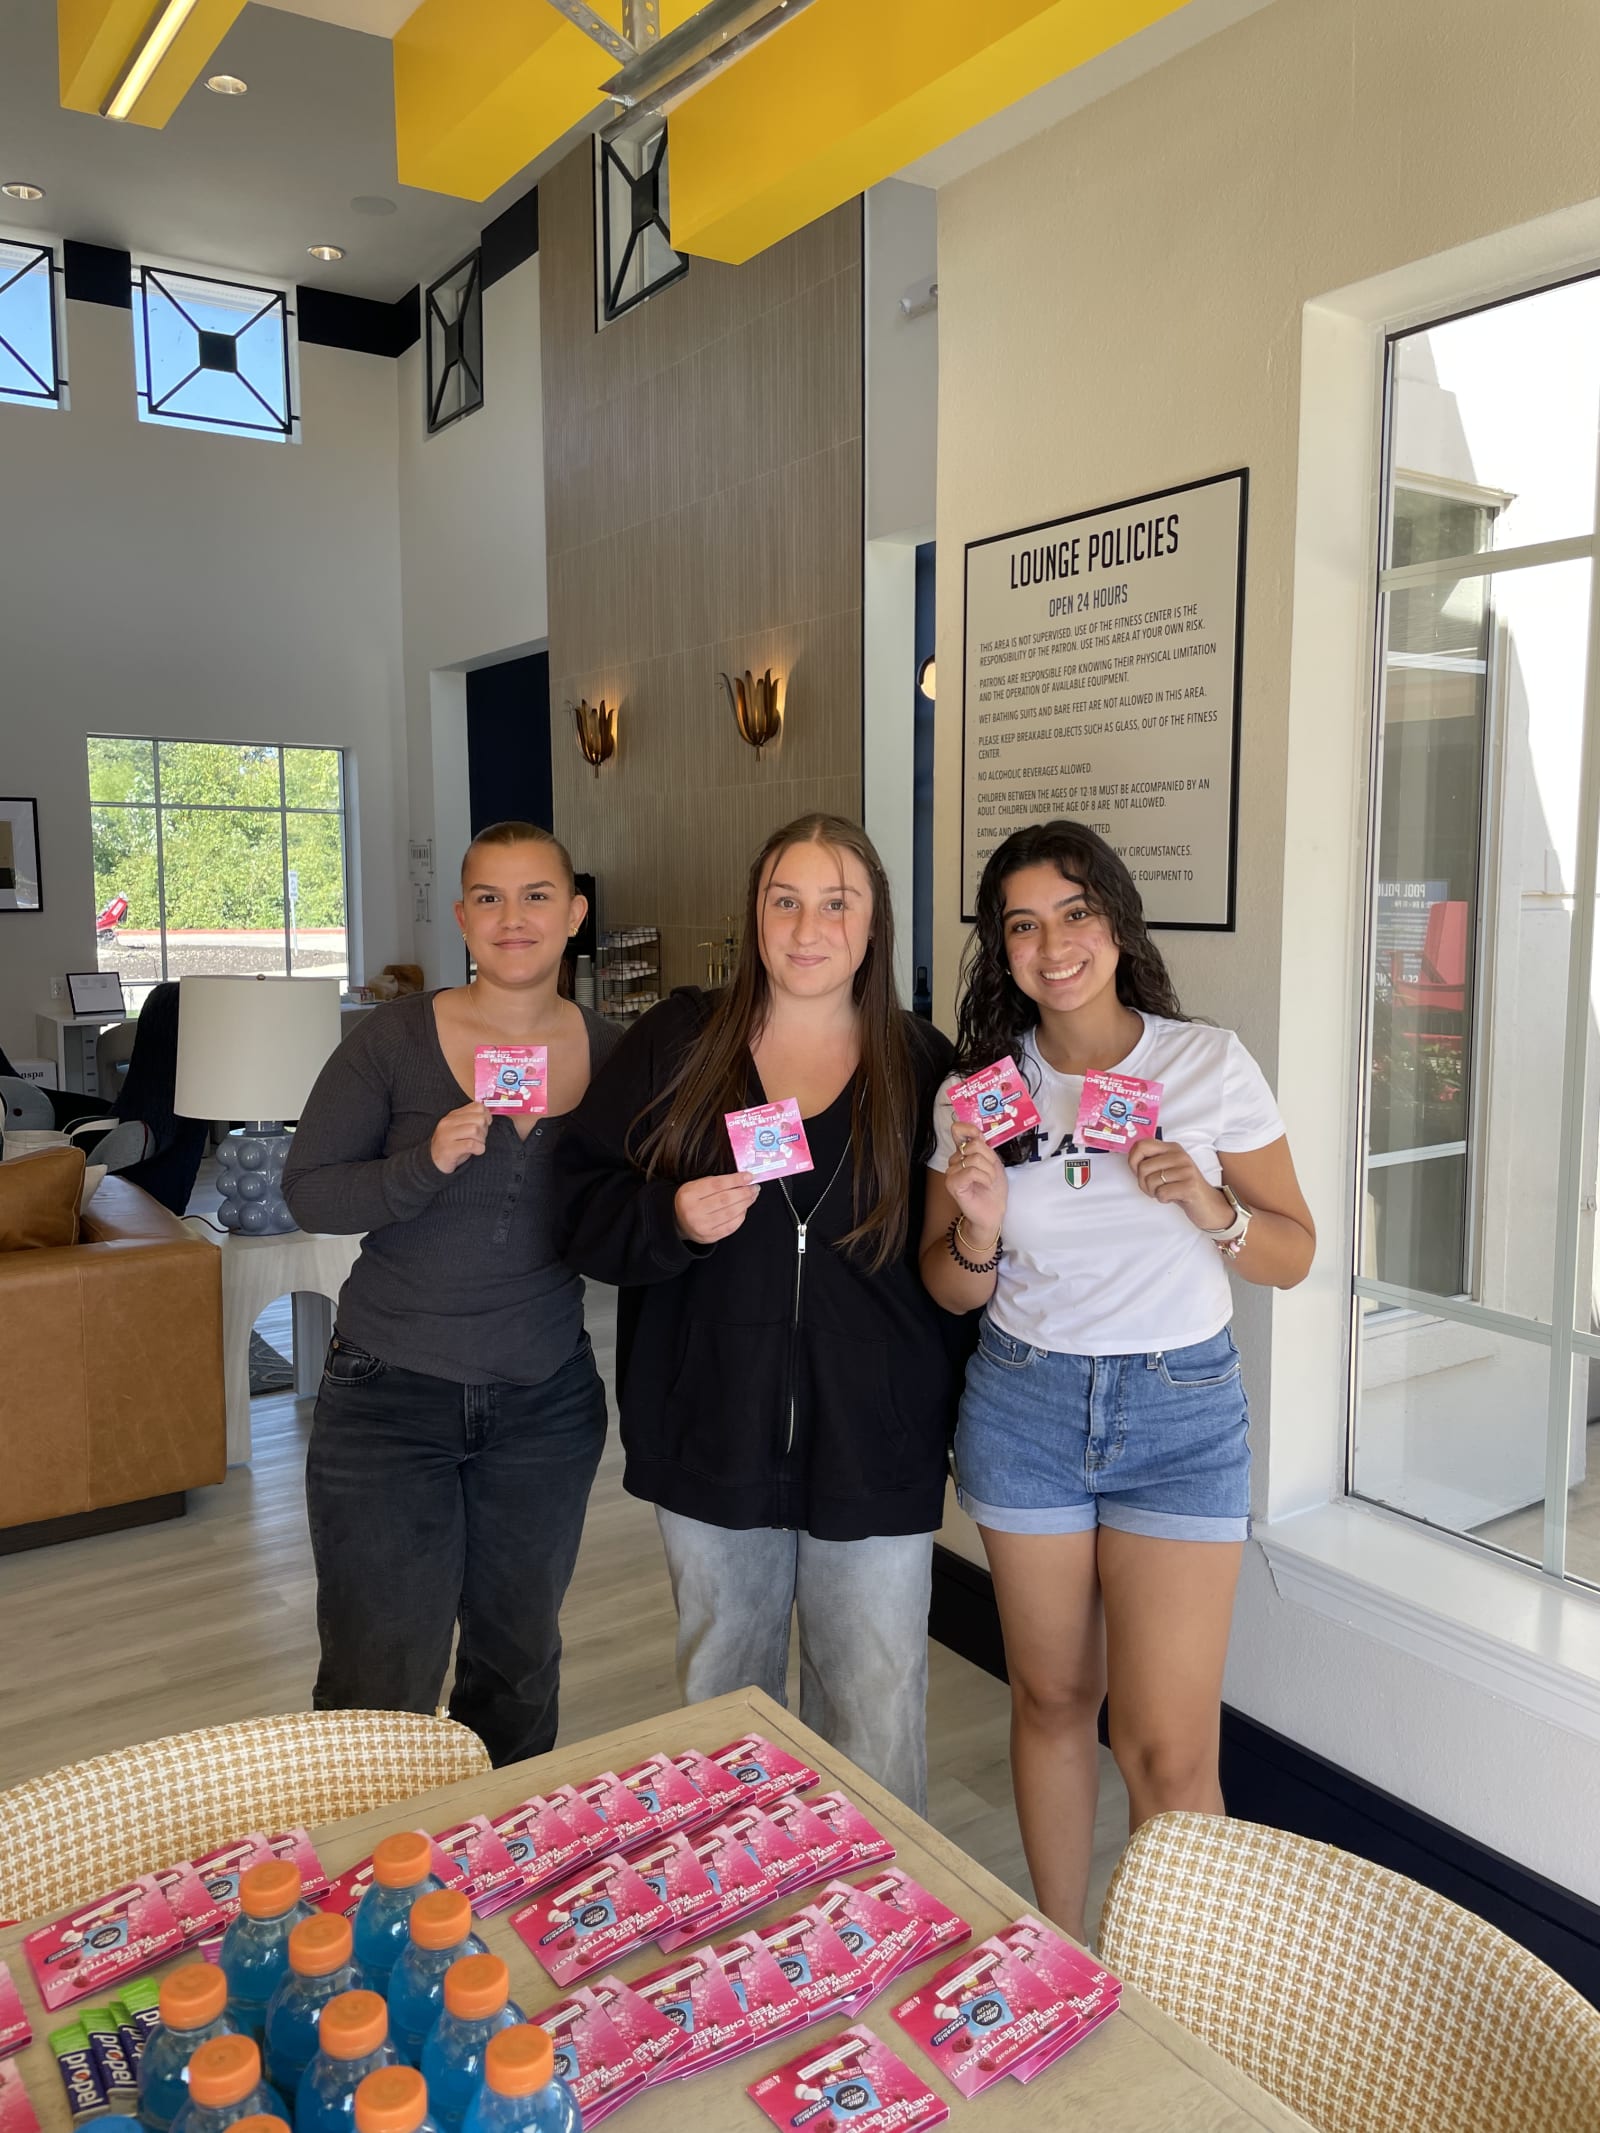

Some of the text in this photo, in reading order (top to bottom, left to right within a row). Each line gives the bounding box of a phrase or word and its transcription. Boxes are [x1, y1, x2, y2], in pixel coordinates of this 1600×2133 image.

[1011, 513, 1178, 589] LOUNGE POLICIES
[1049, 583, 1127, 617] OPEN 24 HOURS
[980, 603, 1197, 652] THIS AREA IS NOT SUPERVISED. USE OF THE FITNESS CENTER IS THE
[980, 618, 1204, 666] RESPONSIBILITY OF THE PATRON. USE THIS AREA AT YOUR OWN RISK.
[979, 642, 1216, 688] PATRONS ARE RESPONSIBLE FOR KNOWING THEIR PHYSICAL LIMITATION
[979, 671, 1129, 702] AND THE OPERATION OF AVAILABLE EQUIPMENT.
[979, 686, 1206, 724] WET BATHING SUITS AND BARE FEET ARE NOT ALLOWED IN THIS AREA.
[978, 710, 1217, 746] PLEASE KEEP BREAKABLE OBJECTS SUCH AS GLASS, OUT OF THE FITNESS
[978, 762, 1091, 781] NO ALCOHOLIC BEVERAGES ALLOWED.
[977, 792, 1006, 802] CHILDREN
[1008, 790, 1036, 801] BETWEEN
[1038, 788, 1048, 798] THE
[1050, 787, 1067, 798] AGES
[1068, 787, 1077, 797] OF
[1099, 784, 1118, 795] MUST
[1120, 783, 1128, 794] BE
[1130, 780, 1184, 793] ACCOMPANIED
[1186, 779, 1196, 790] BY
[1198, 778, 1209, 788] AN
[998, 804, 1027, 814] CHILDREN
[1029, 802, 1050, 813] UNDER
[1052, 802, 1064, 812] THE
[1066, 801, 1078, 811] AGE
[1080, 800, 1089, 810] OF
[1091, 800, 1095, 810] 8
[1097, 799, 1110, 809] ARE
[1114, 798, 1128, 808] NOT
[1130, 796, 1166, 808] ALLOWED.
[977, 827, 997, 837] EATING
[1128, 845, 1192, 856] CIRCUMSTANCES.
[1138, 870, 1181, 880] EQUIPMENT
[1183, 870, 1193, 880] TO
[577, 1927, 615, 1953] BETTER
[932, 2017, 969, 2044] chewable!
[949, 2009, 1039, 2078] FEEL BETTER FAST!
[93, 2034, 138, 2084] propel
[61, 2053, 103, 2108] propel
[794, 2100, 832, 2123] chewable!
[880, 2098, 907, 2116] FEEL
